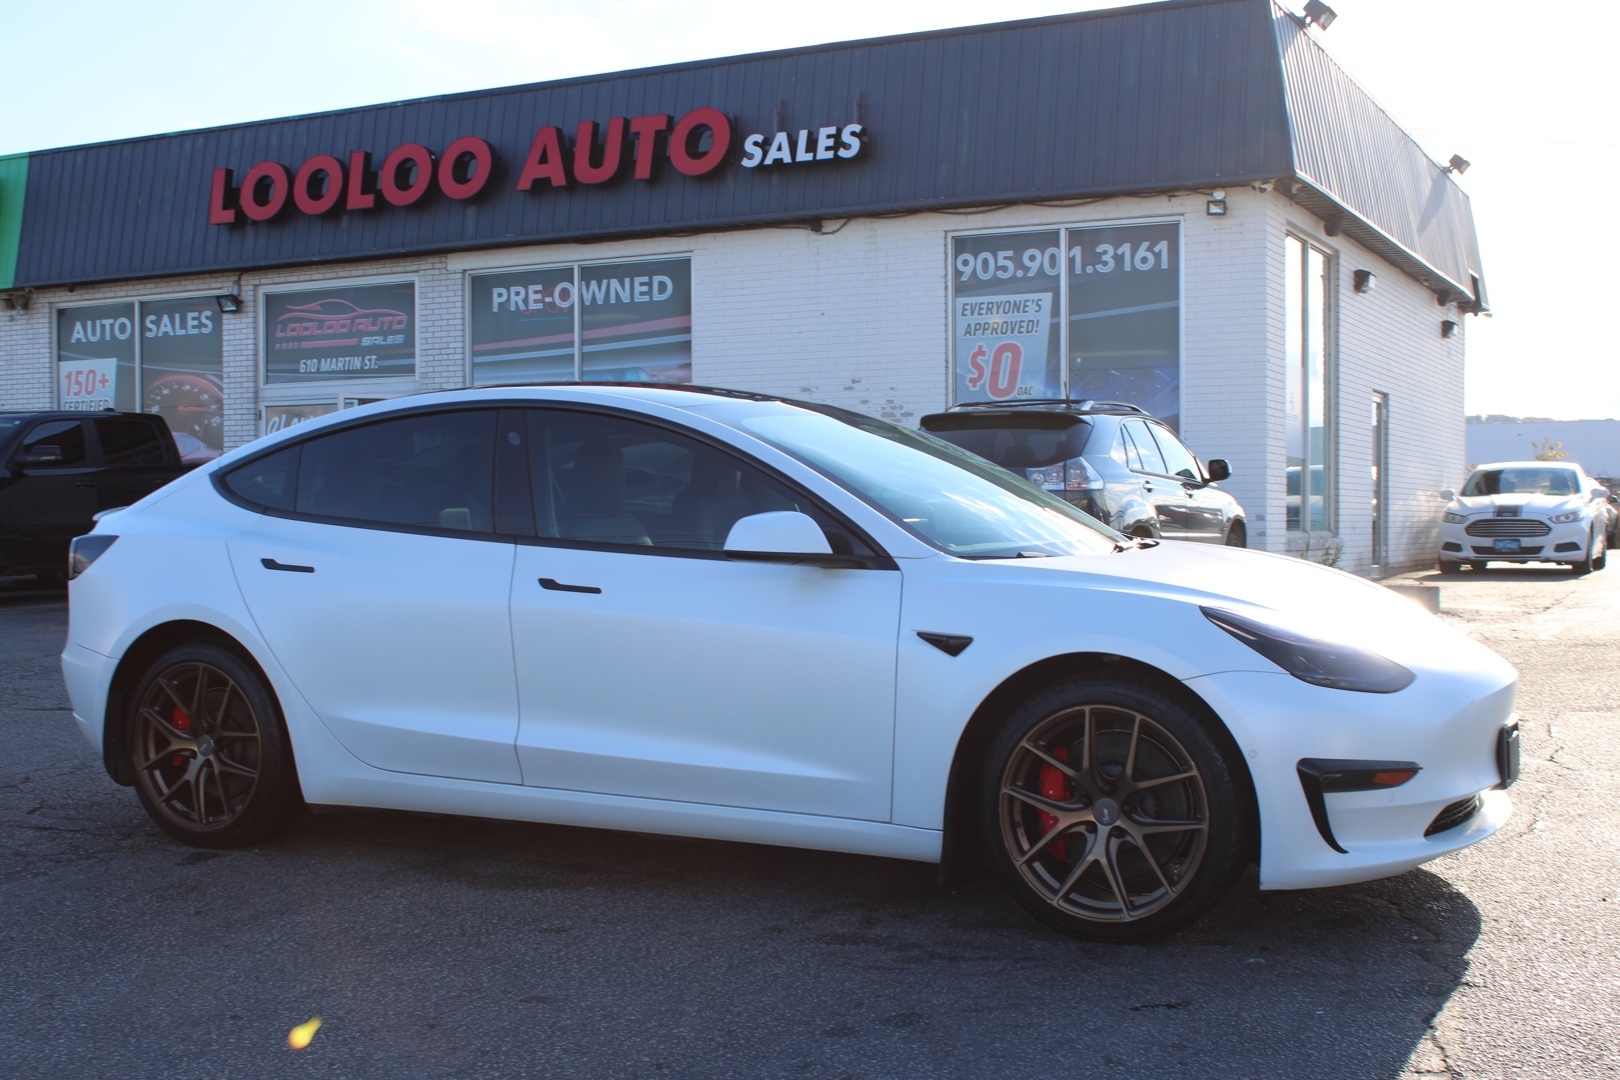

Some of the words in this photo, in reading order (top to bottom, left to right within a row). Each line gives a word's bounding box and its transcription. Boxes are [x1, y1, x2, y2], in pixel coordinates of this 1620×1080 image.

[209, 136, 493, 225] LOOLOO
[517, 107, 732, 192] AUTO
[741, 123, 863, 169] SALES
[956, 240, 1169, 282] 905.901.3161
[492, 275, 673, 312] PRE-OWNED
[961, 298, 1042, 318] EVERYONE'S
[71, 317, 132, 344] AUTO
[144, 311, 213, 338] SALES
[275, 319, 352, 338] LOOLOO
[352, 315, 408, 333] AUTO
[963, 319, 1039, 338] APPROVED!
[361, 334, 405, 347] SALES
[299, 359, 318, 373] 610
[320, 357, 362, 372] MARTIN
[363, 355, 379, 370] ST.
[968, 342, 1022, 399] $0
[1017, 386, 1033, 396] OAC
[65, 369, 109, 396] 150+
